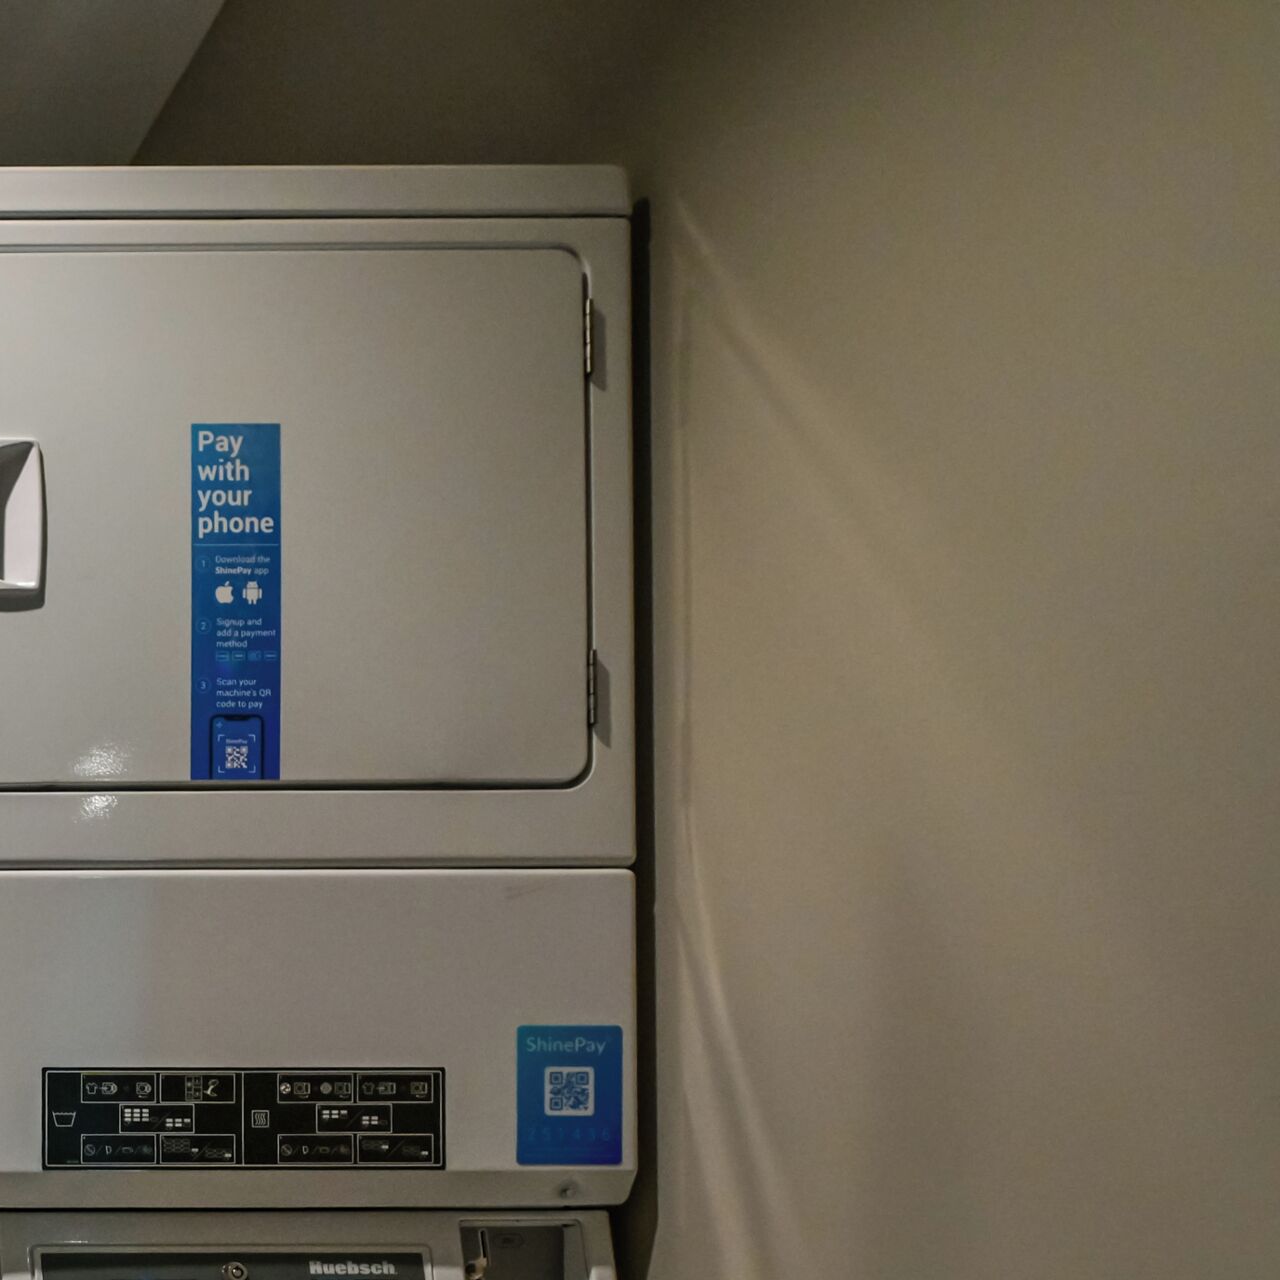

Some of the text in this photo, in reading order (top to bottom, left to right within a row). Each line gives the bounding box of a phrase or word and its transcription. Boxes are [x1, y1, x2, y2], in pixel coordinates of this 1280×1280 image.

[198, 431, 243, 458] Pay
[198, 459, 249, 481] with
[198, 490, 252, 512] your
[198, 511, 274, 539] phone
[215, 567, 251, 575] ShinePay
[217, 618, 244, 627] Signup
[217, 629, 231, 637] add
[241, 629, 276, 638] payment
[217, 640, 247, 648] method
[217, 678, 256, 687] Scan your
[217, 689, 271, 697] machine's QR
[248, 701, 262, 709] pay
[526, 1037, 606, 1055] ShinePay
[309, 1261, 395, 1275] Huebsch
